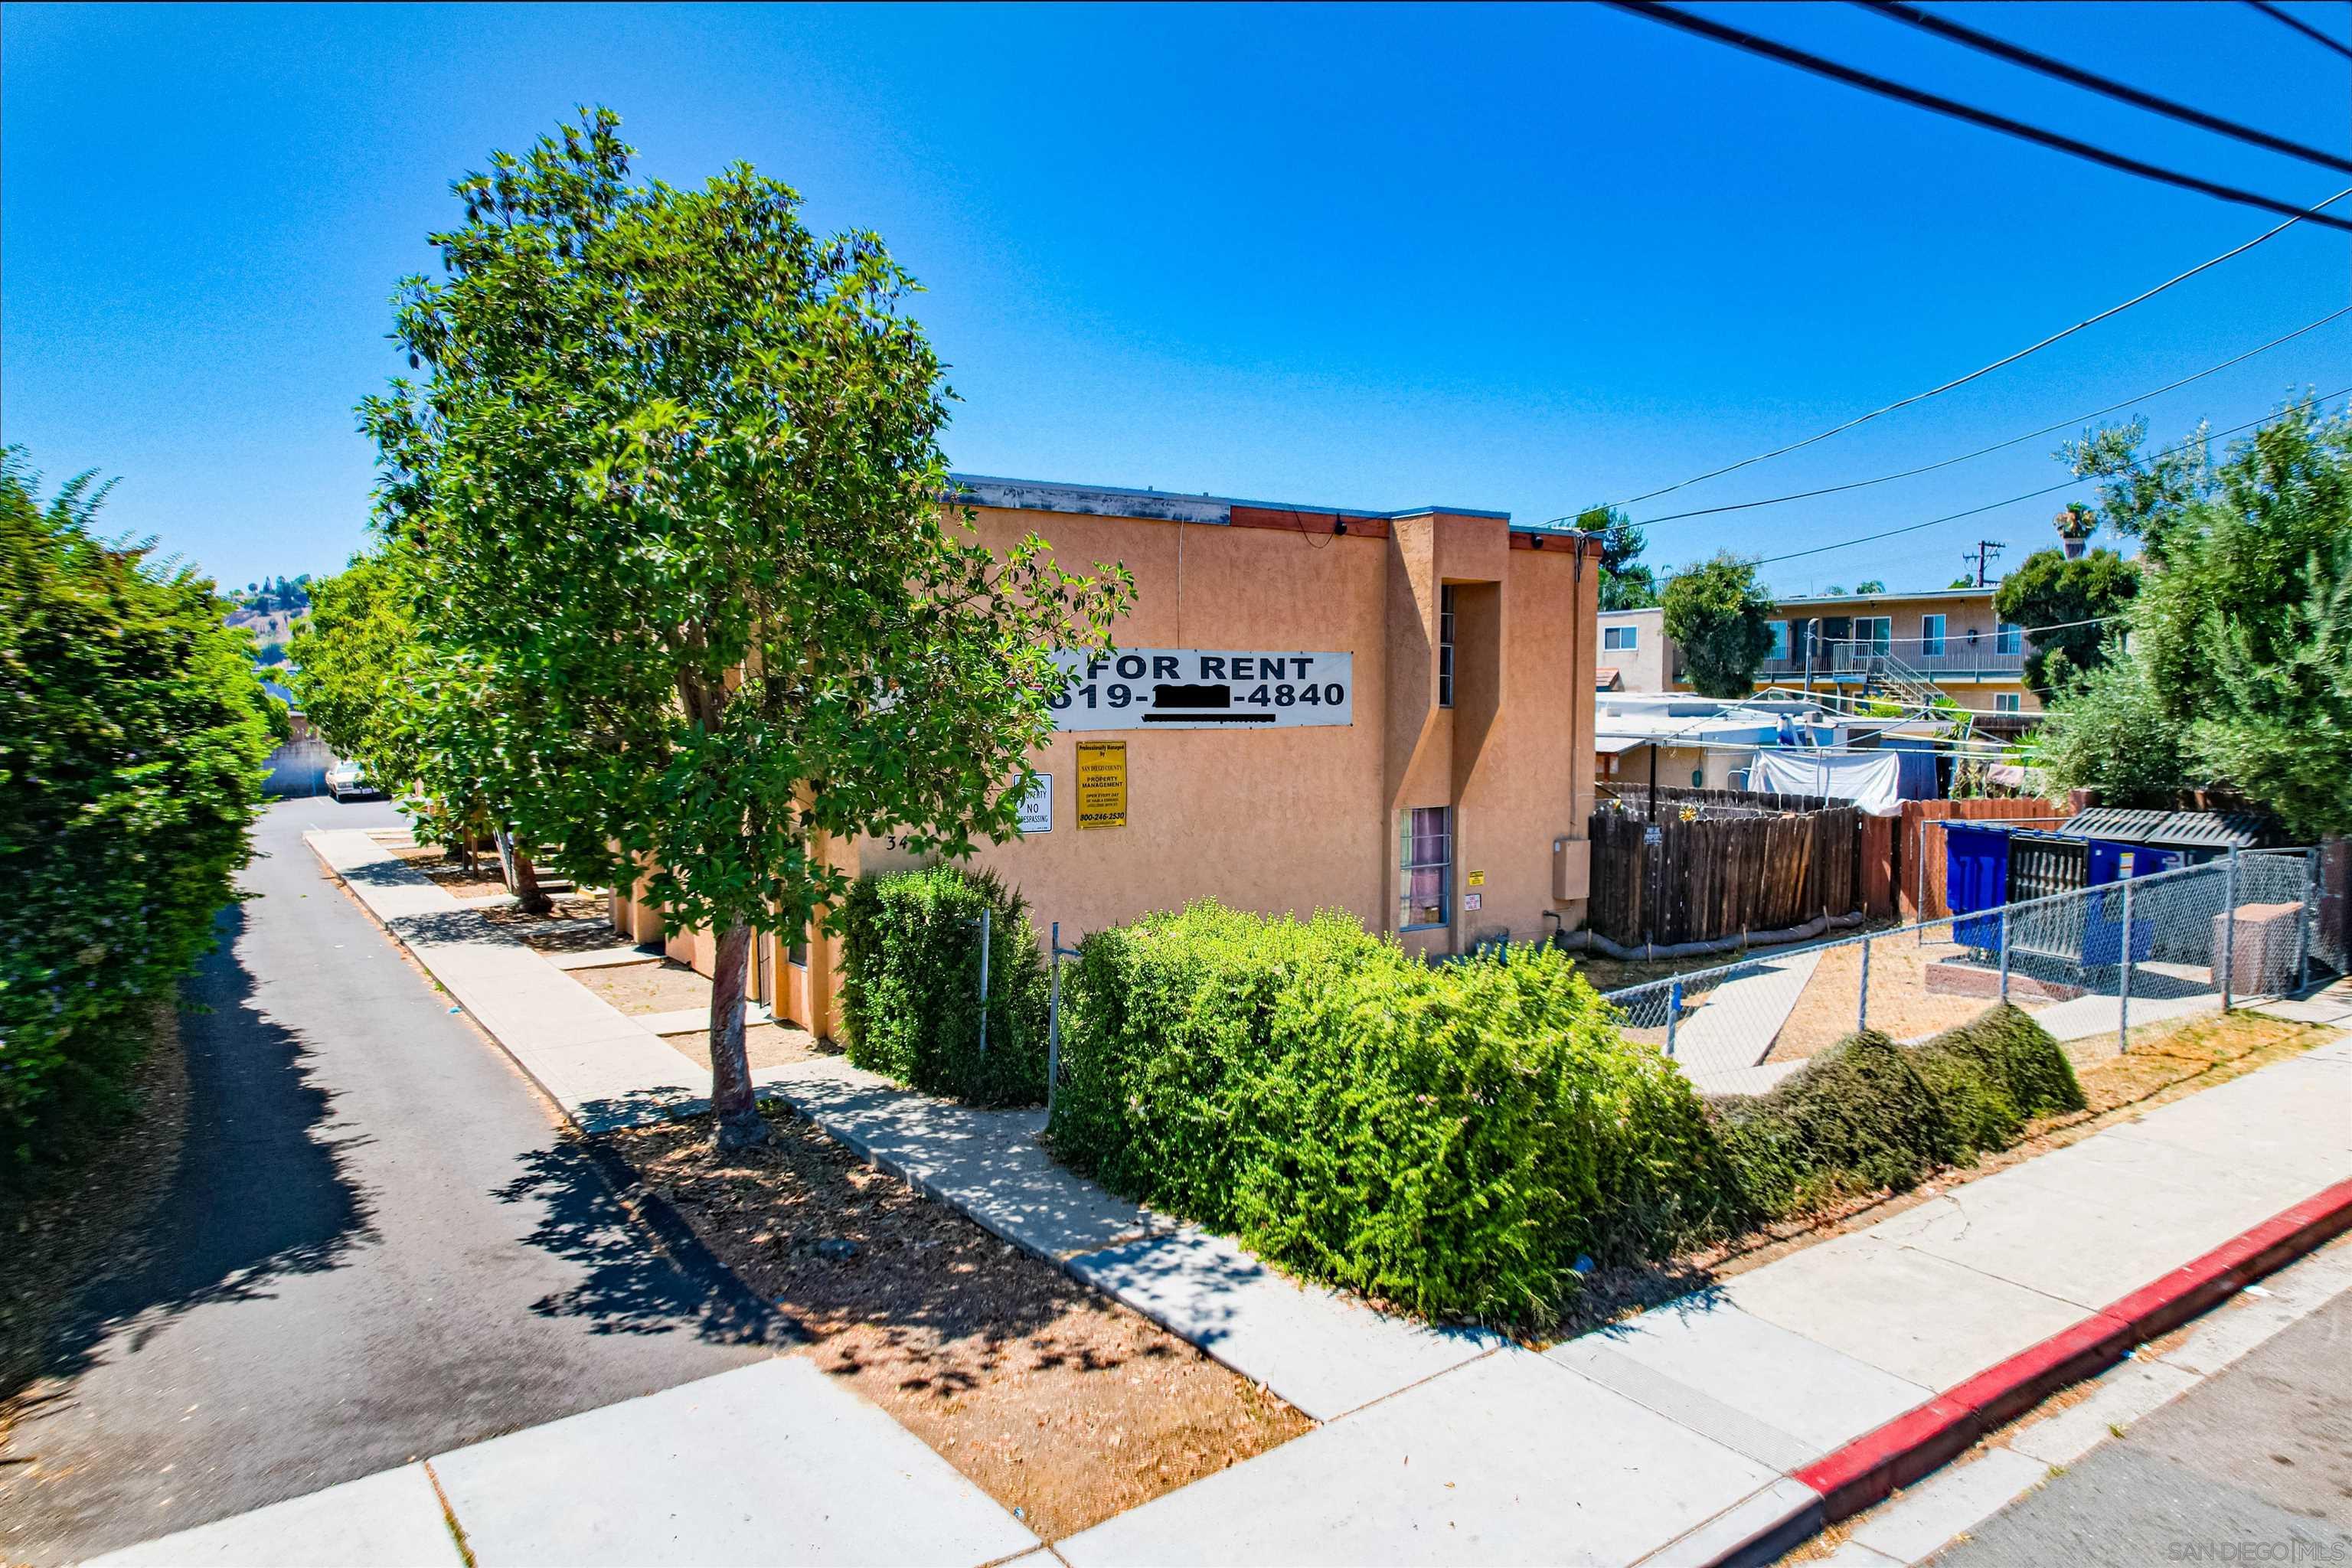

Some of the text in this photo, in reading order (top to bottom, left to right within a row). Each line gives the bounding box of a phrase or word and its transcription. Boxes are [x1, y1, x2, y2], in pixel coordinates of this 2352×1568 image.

[1087, 655, 1314, 680] FOR RENT
[1027, 804, 1038, 813] NO
